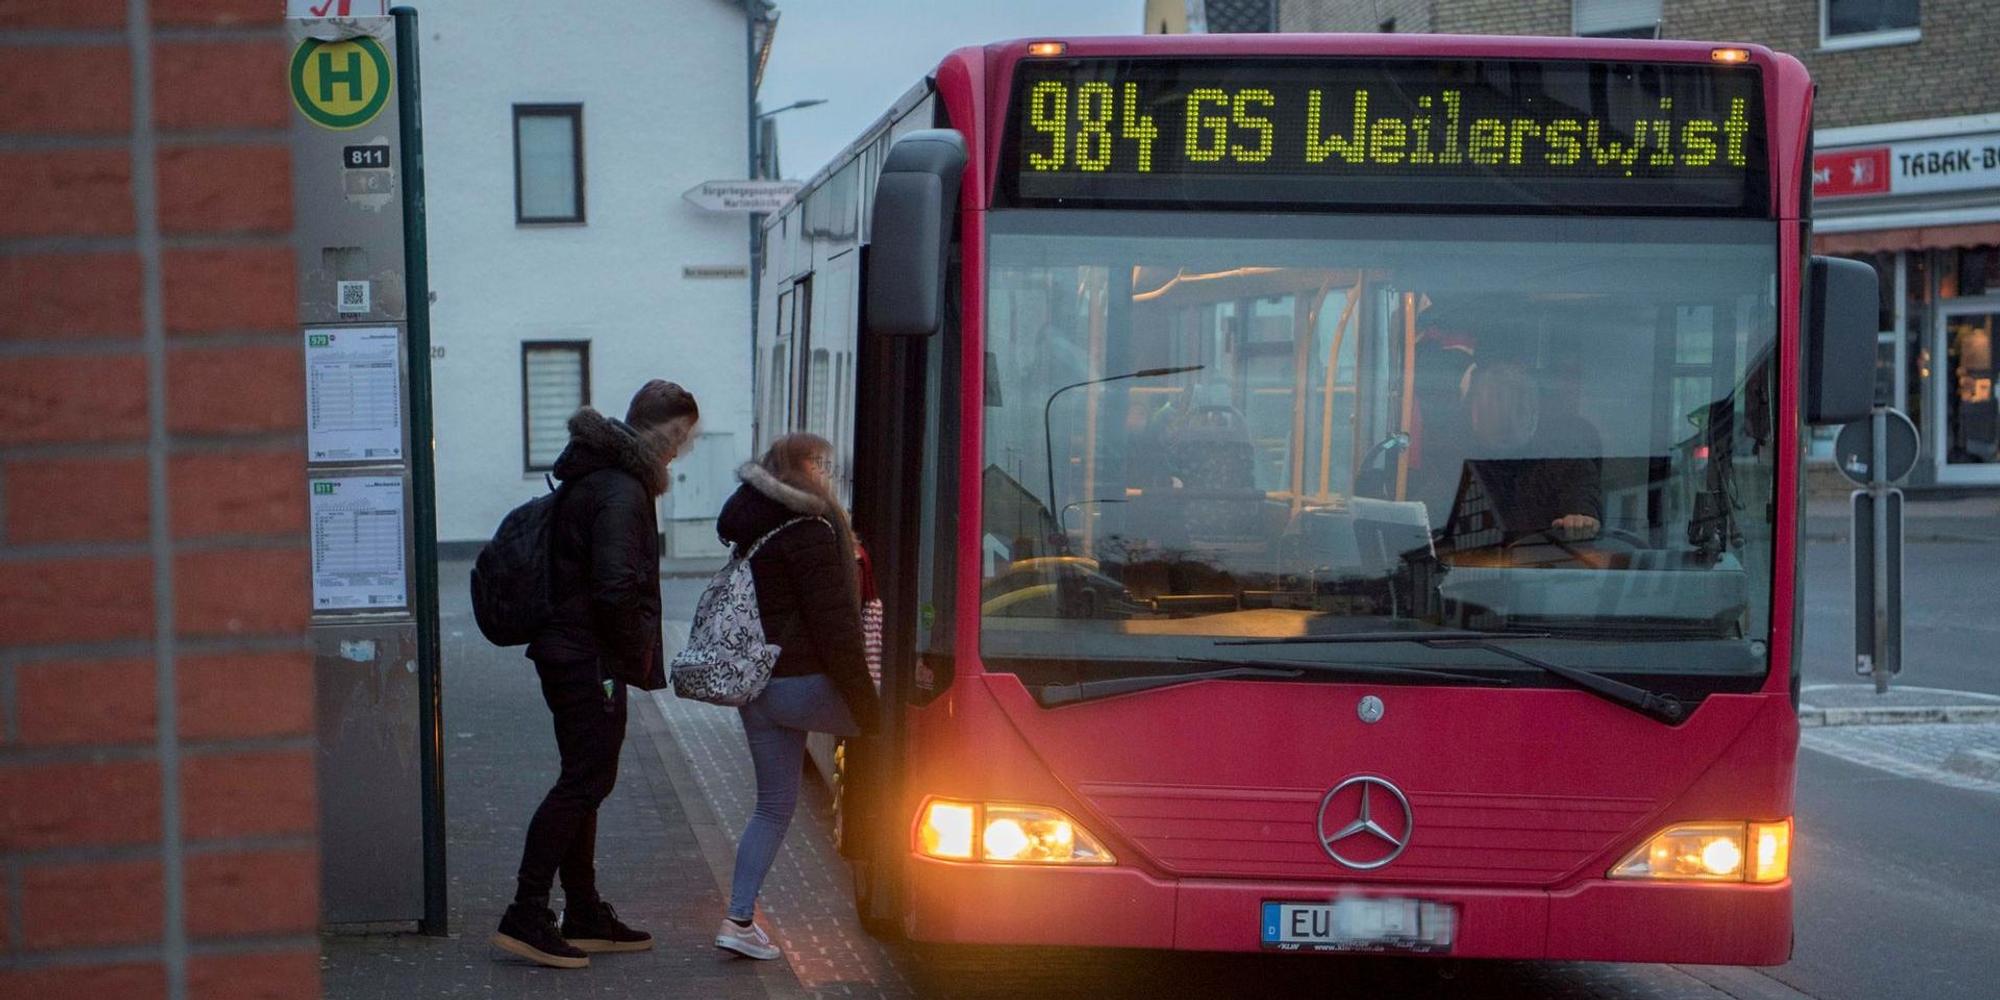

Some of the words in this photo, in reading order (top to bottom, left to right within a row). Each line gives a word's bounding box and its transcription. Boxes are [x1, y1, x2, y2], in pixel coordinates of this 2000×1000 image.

[319, 52, 363, 102] H
[1029, 81, 1158, 172] 984
[1185, 87, 1275, 162] GS
[1305, 89, 1748, 168] Weilerswist
[352, 150, 382, 164] 811
[1900, 146, 2000, 178] TABAK-B
[1268, 926, 1275, 935] D
[1291, 909, 1331, 938] EU
